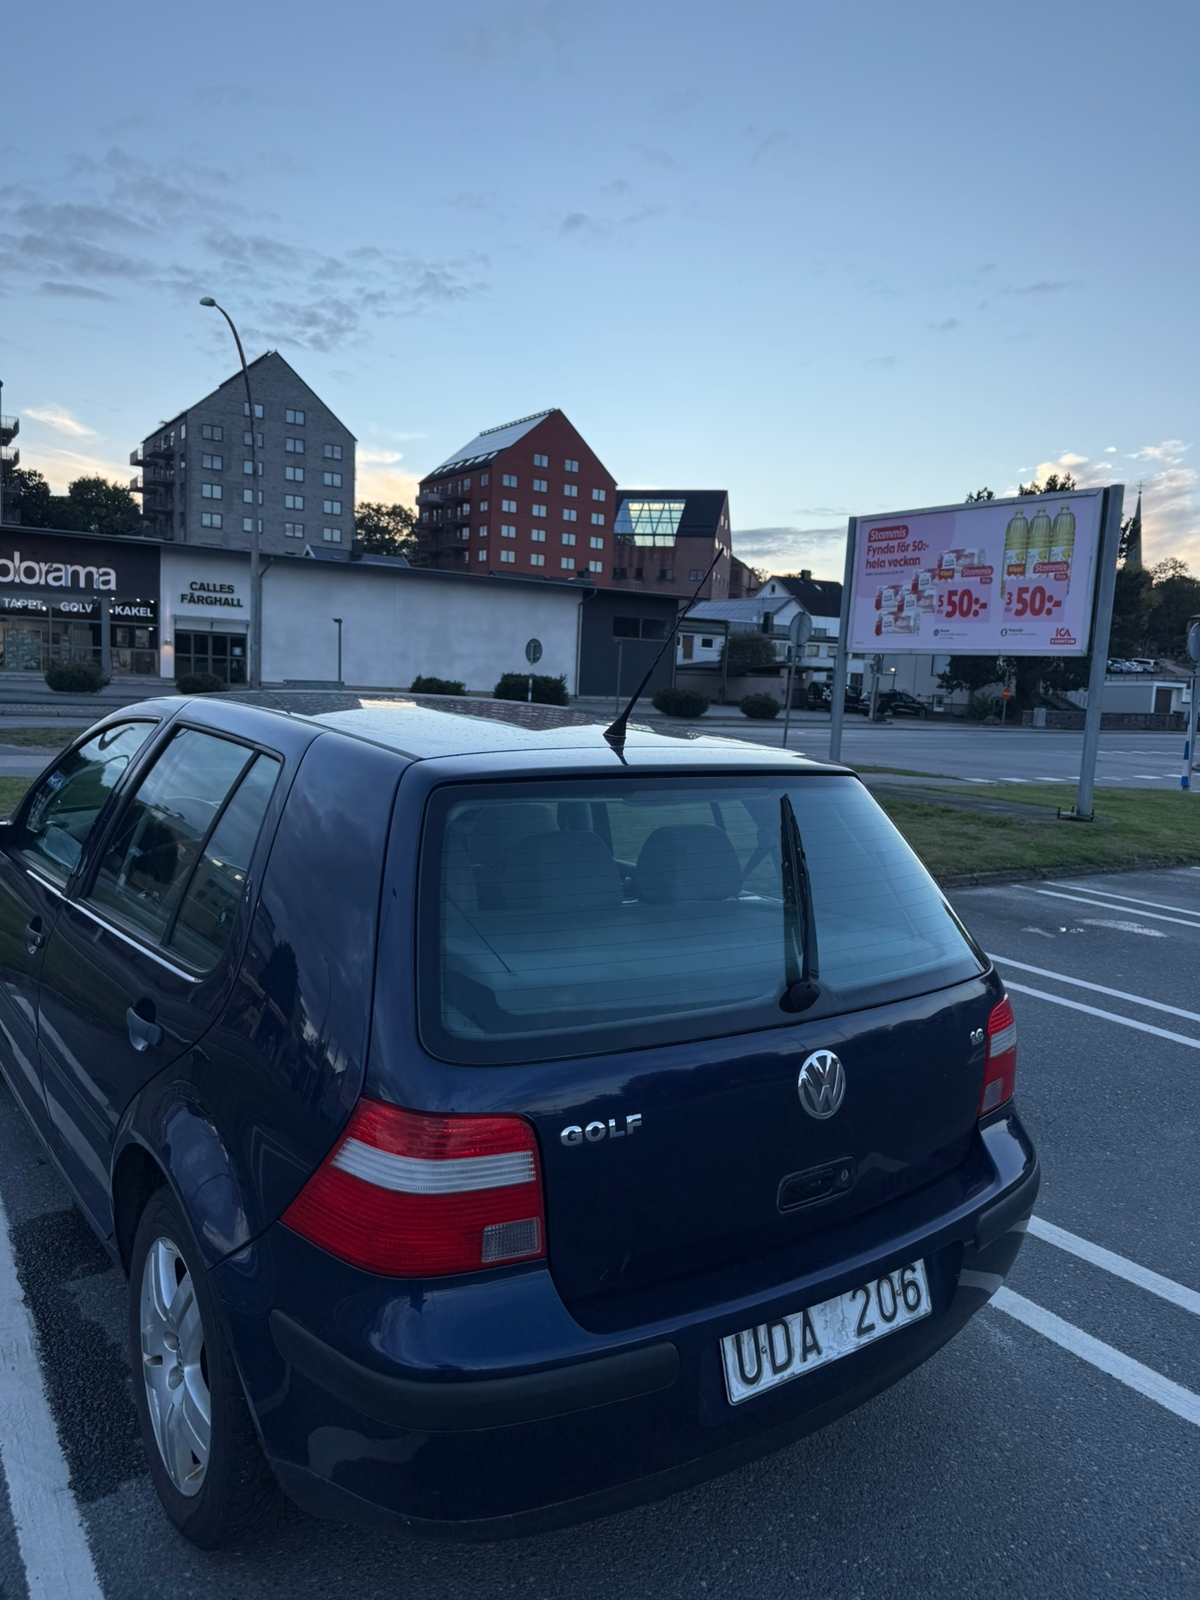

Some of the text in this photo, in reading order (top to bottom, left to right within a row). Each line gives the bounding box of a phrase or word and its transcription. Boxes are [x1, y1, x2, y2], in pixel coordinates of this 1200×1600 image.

[870, 527, 906, 540] Stammis
[867, 540, 929, 557] Fynda för 50:-
[865, 555, 921, 569] hela veckan
[1035, 562, 1067, 572] Stammis
[963, 567, 991, 576] Stammis
[190, 582, 235, 594] CALLES
[3, 598, 43, 610] TAPET
[180, 592, 243, 608] FÄRGHALL
[938, 588, 987, 618] 5 50:-
[1006, 585, 1062, 617] 3 50:-
[60, 602, 93, 613] GOLV
[115, 605, 154, 617] KAKEL
[1055, 628, 1071, 637] ICA
[560, 1113, 642, 1146] GOLF
[735, 1264, 921, 1385] UDA 206
